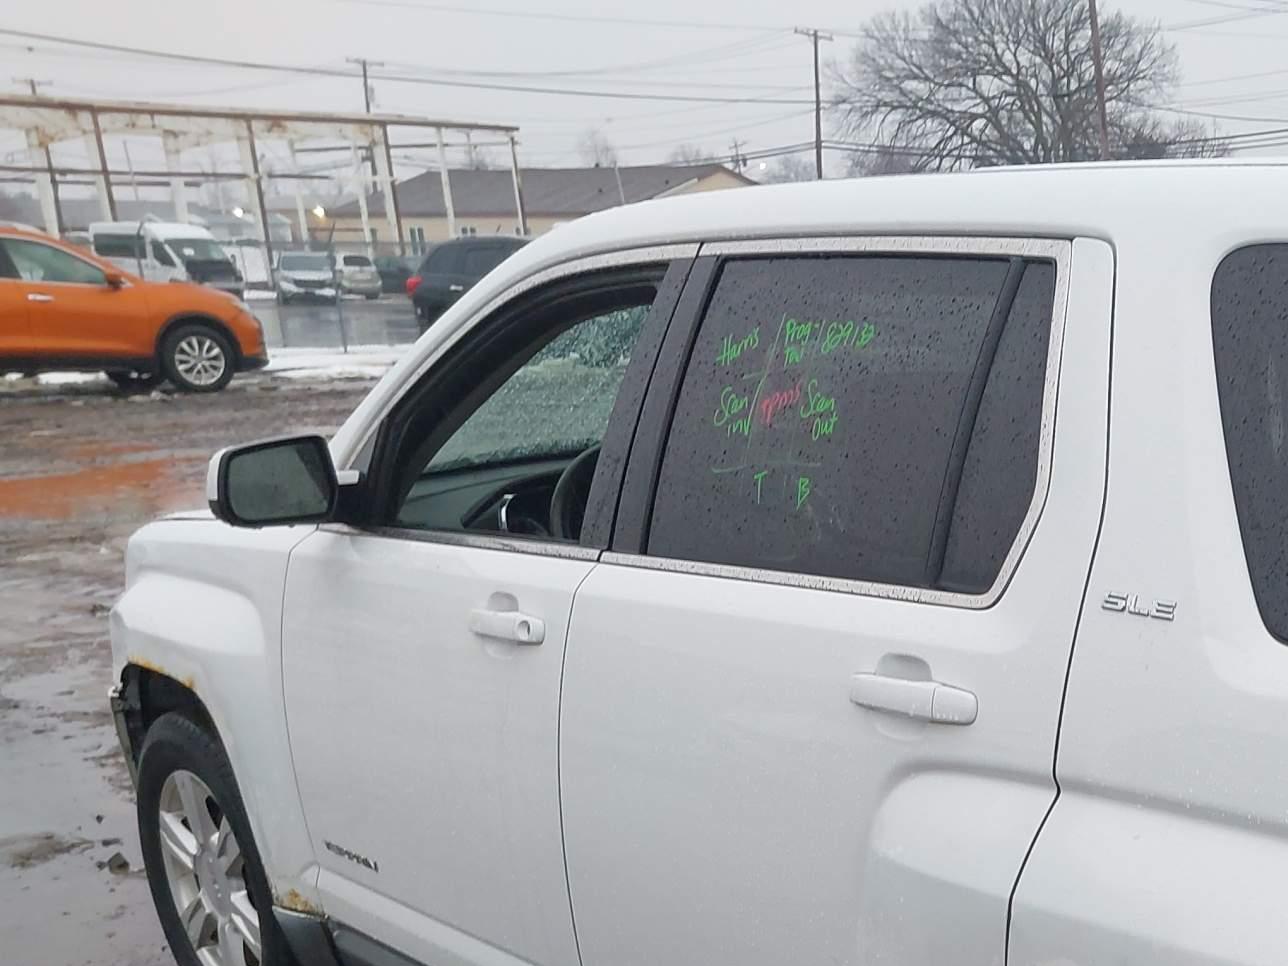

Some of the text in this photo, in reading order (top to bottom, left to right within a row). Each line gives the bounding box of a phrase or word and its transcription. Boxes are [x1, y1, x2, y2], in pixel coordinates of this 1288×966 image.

[714, 386, 748, 427] Scan
[800, 379, 835, 418] Scan
[753, 470, 769, 505] T
[796, 477, 811, 512] B
[1101, 591, 1177, 622] SLE
